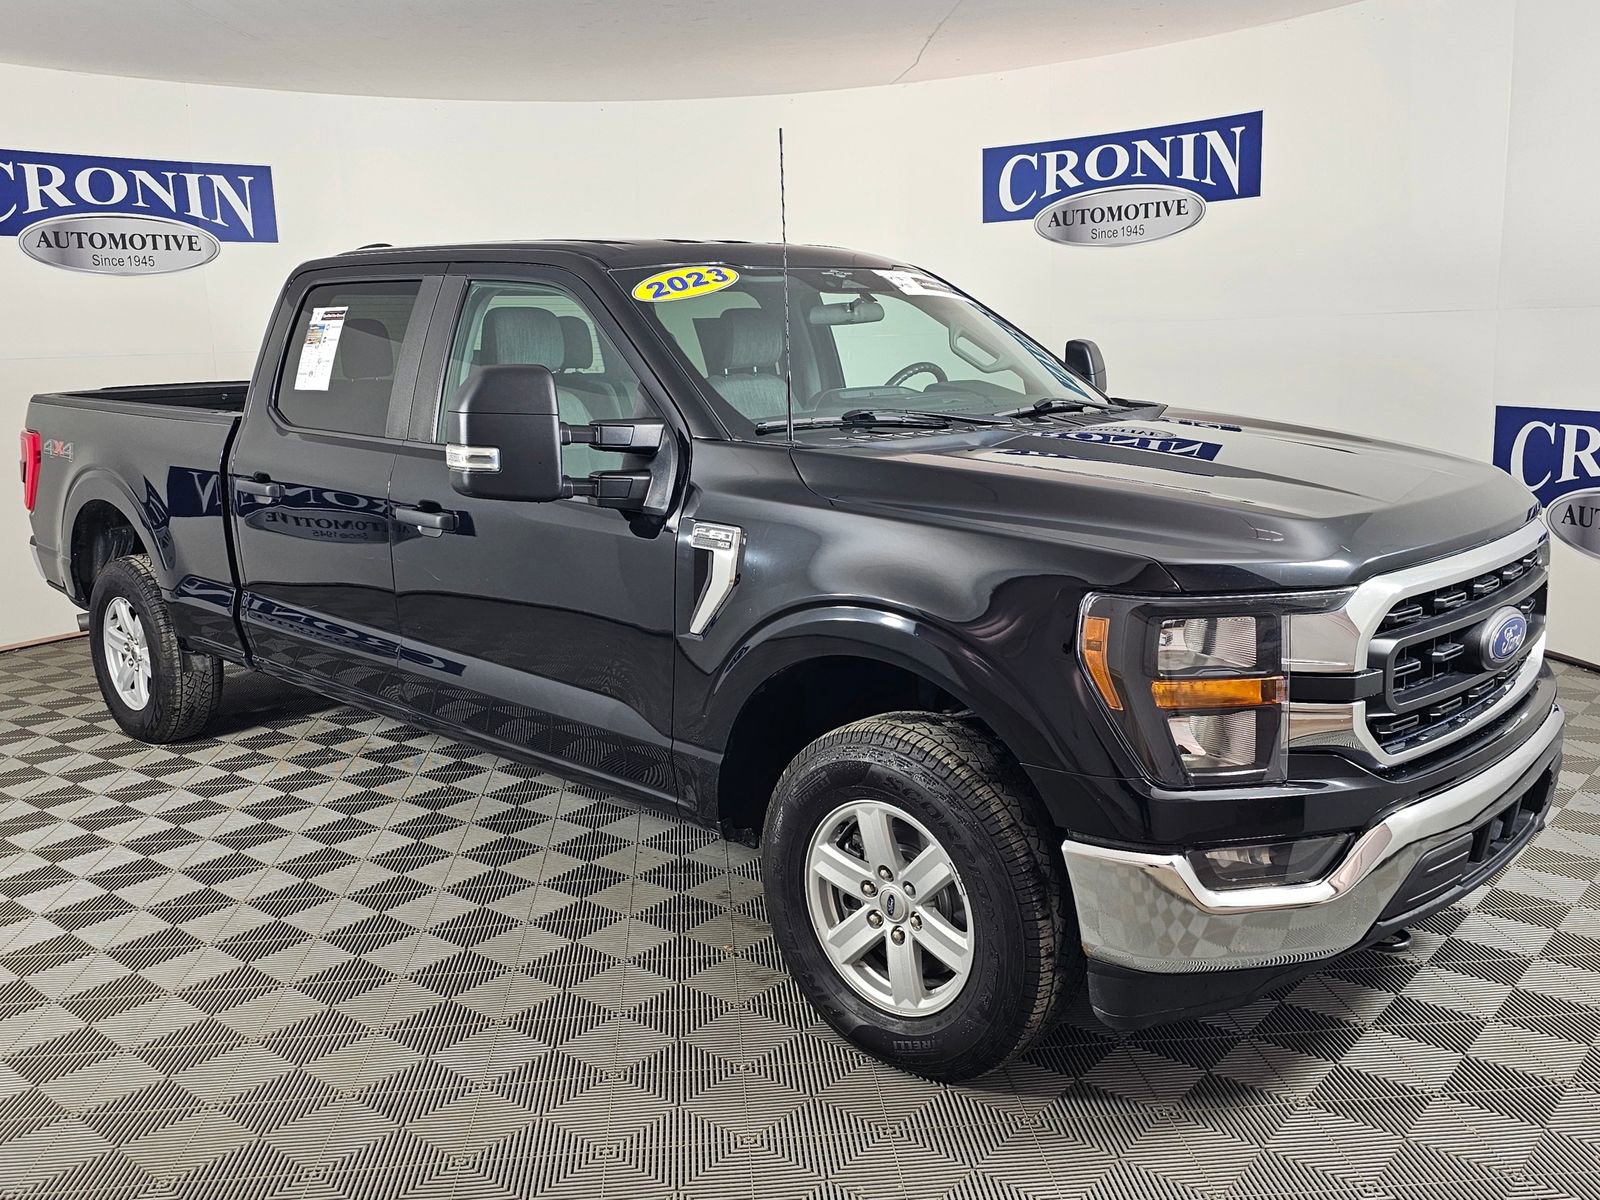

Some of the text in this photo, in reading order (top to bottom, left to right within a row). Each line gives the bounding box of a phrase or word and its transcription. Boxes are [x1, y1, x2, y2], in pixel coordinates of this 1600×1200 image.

[998, 125, 1246, 213] CRONIN
[1047, 198, 1189, 228] AUTOMOTIVE
[36, 230, 202, 252] AUTOMOTIVE
[1090, 224, 1145, 240] Since 1945
[92, 253, 155, 267] Since 1945
[646, 268, 729, 299] 2023
[1501, 623, 1523, 654] Ford
